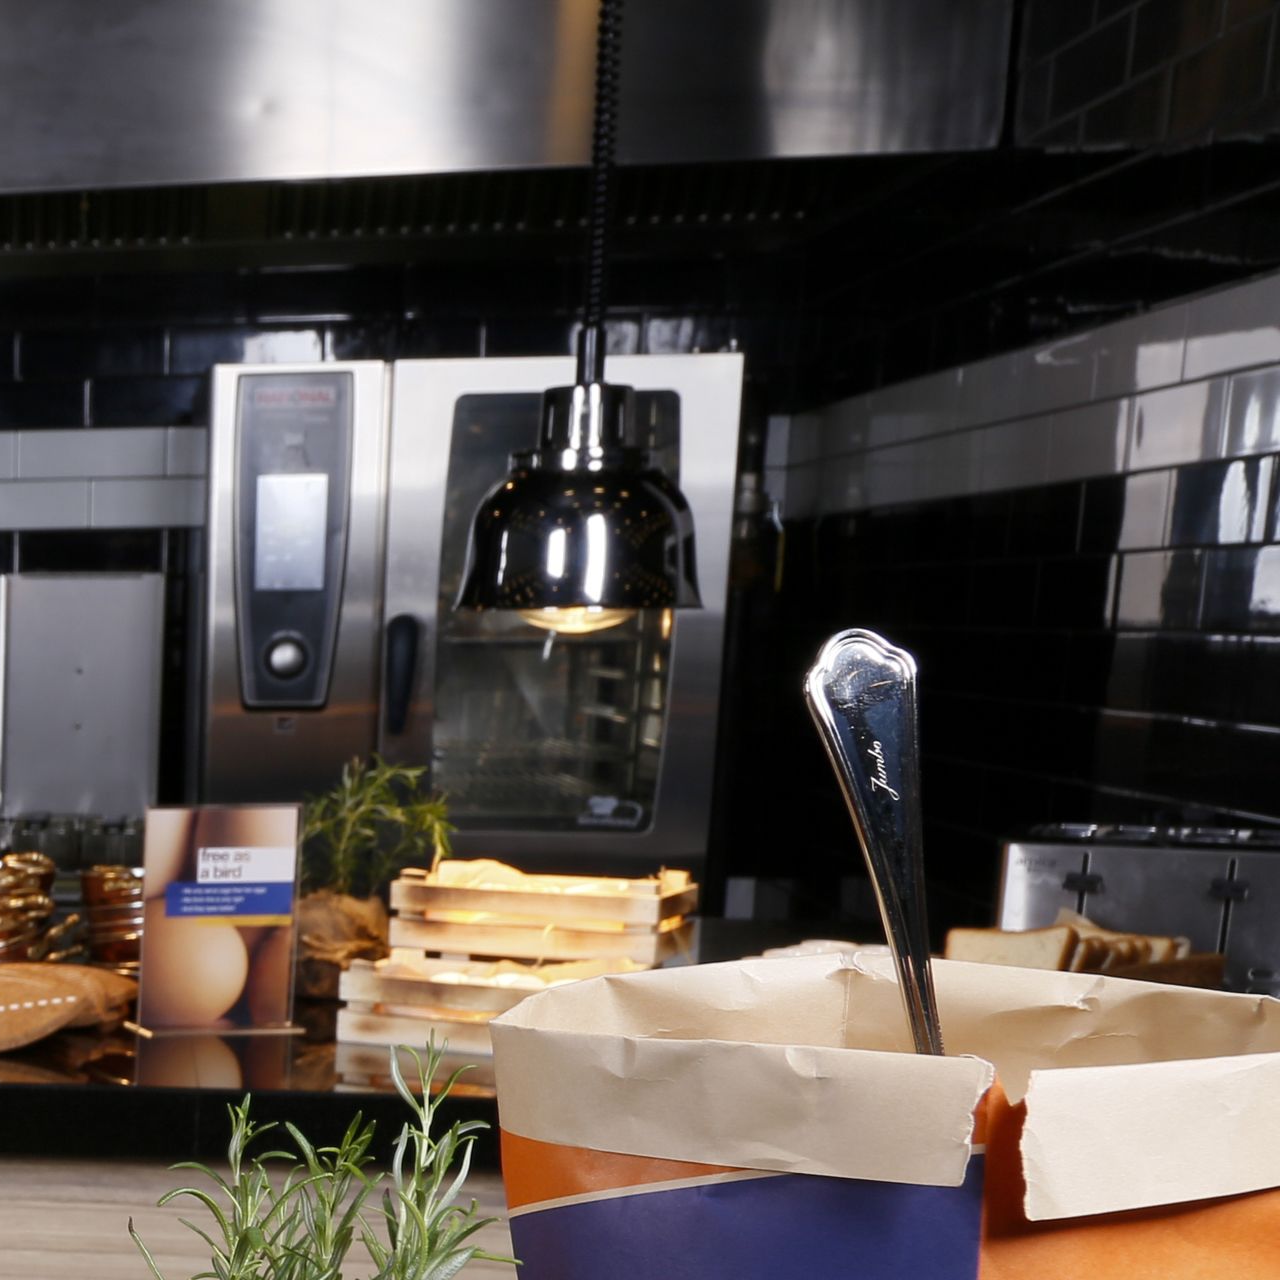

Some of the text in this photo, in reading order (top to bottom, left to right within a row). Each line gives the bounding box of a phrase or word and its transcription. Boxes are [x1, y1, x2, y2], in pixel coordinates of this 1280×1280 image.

[867, 740, 900, 801] Jumbo
[201, 847, 251, 861] free as
[200, 866, 242, 879] a bird
